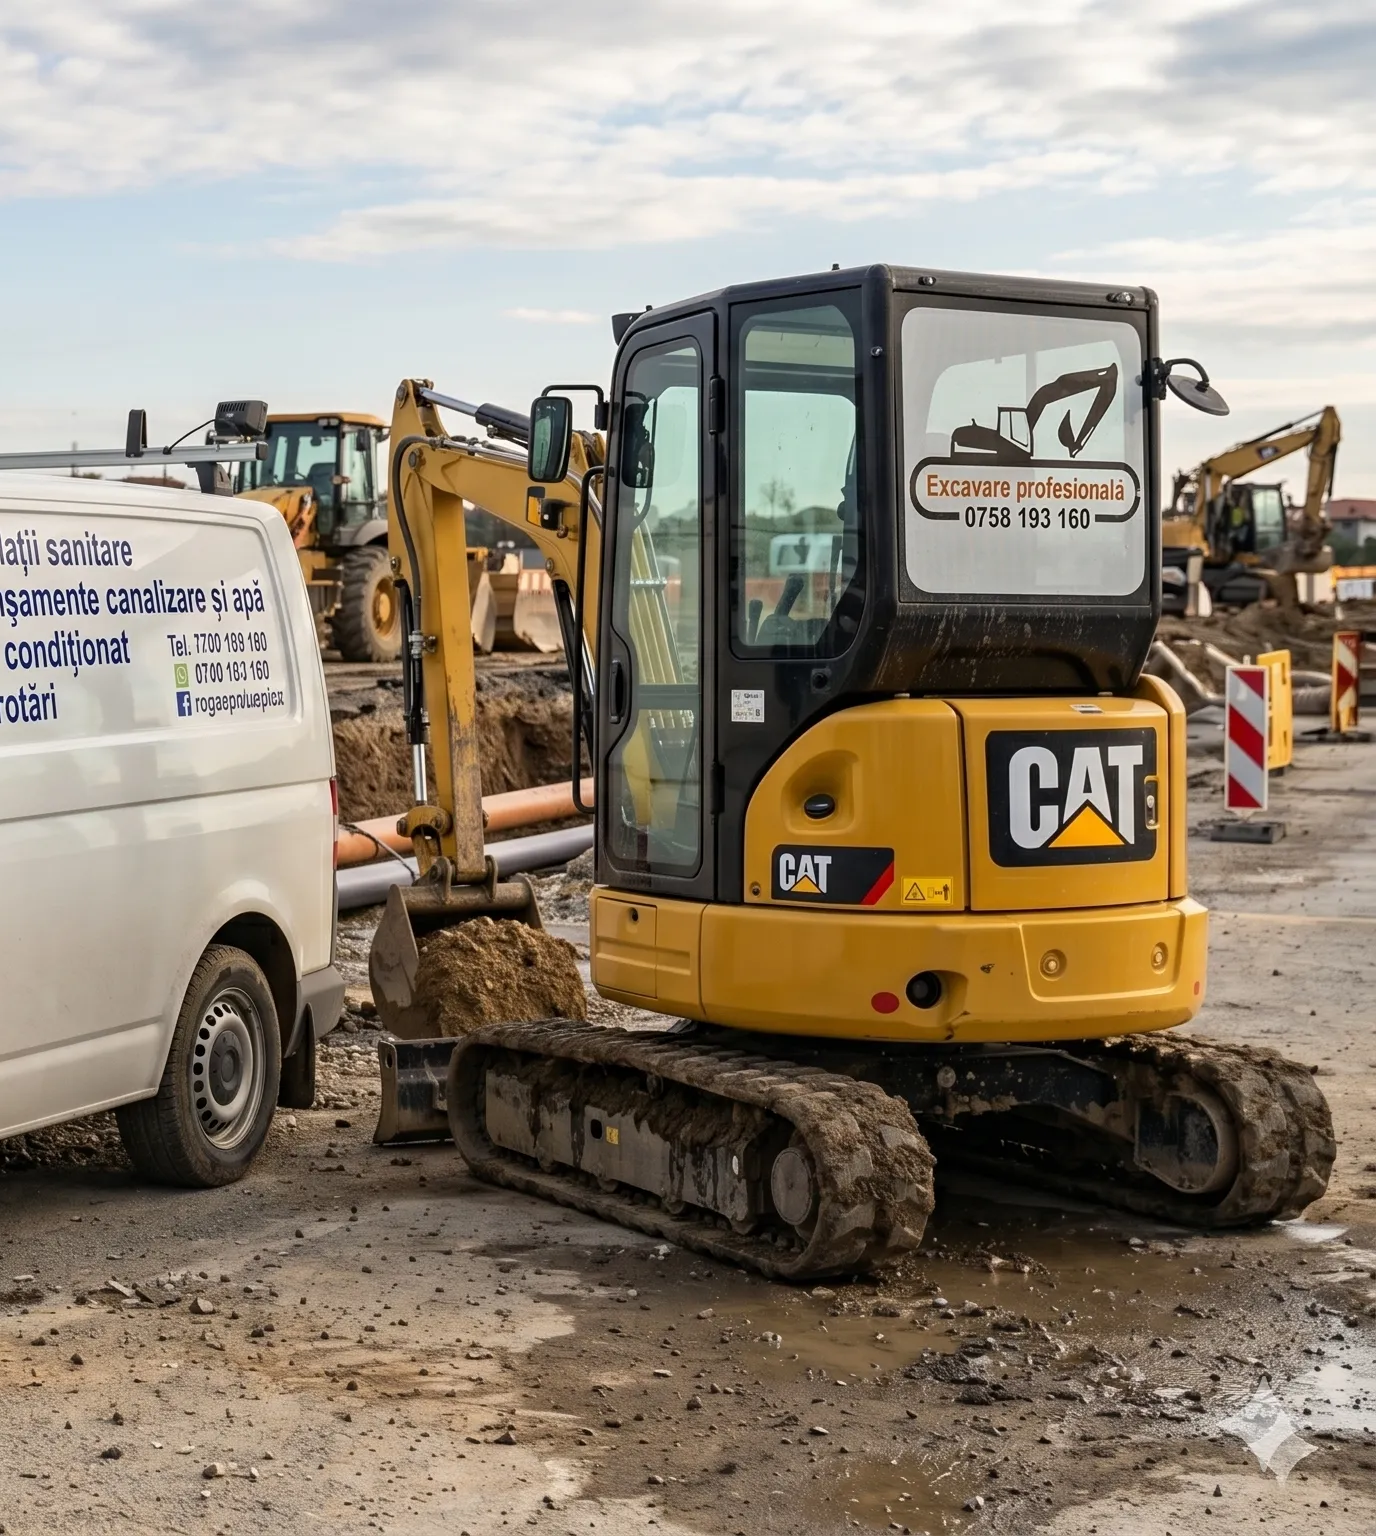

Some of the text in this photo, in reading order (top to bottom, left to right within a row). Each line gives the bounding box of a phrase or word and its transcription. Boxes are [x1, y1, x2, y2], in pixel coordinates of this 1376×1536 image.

[927, 474, 1011, 498] Excavare
[965, 506, 1090, 529] 0758 193 160
[46, 531, 132, 566] sanitare
[106, 579, 206, 614] canalizare
[233, 579, 265, 620] apă
[5, 629, 130, 678] condiționat
[167, 634, 191, 656] Tel.
[248, 631, 267, 652] 180
[195, 662, 223, 684] 0700
[250, 660, 269, 680] 160
[1008, 745, 1143, 849] CAT
[779, 853, 832, 894] CAT
